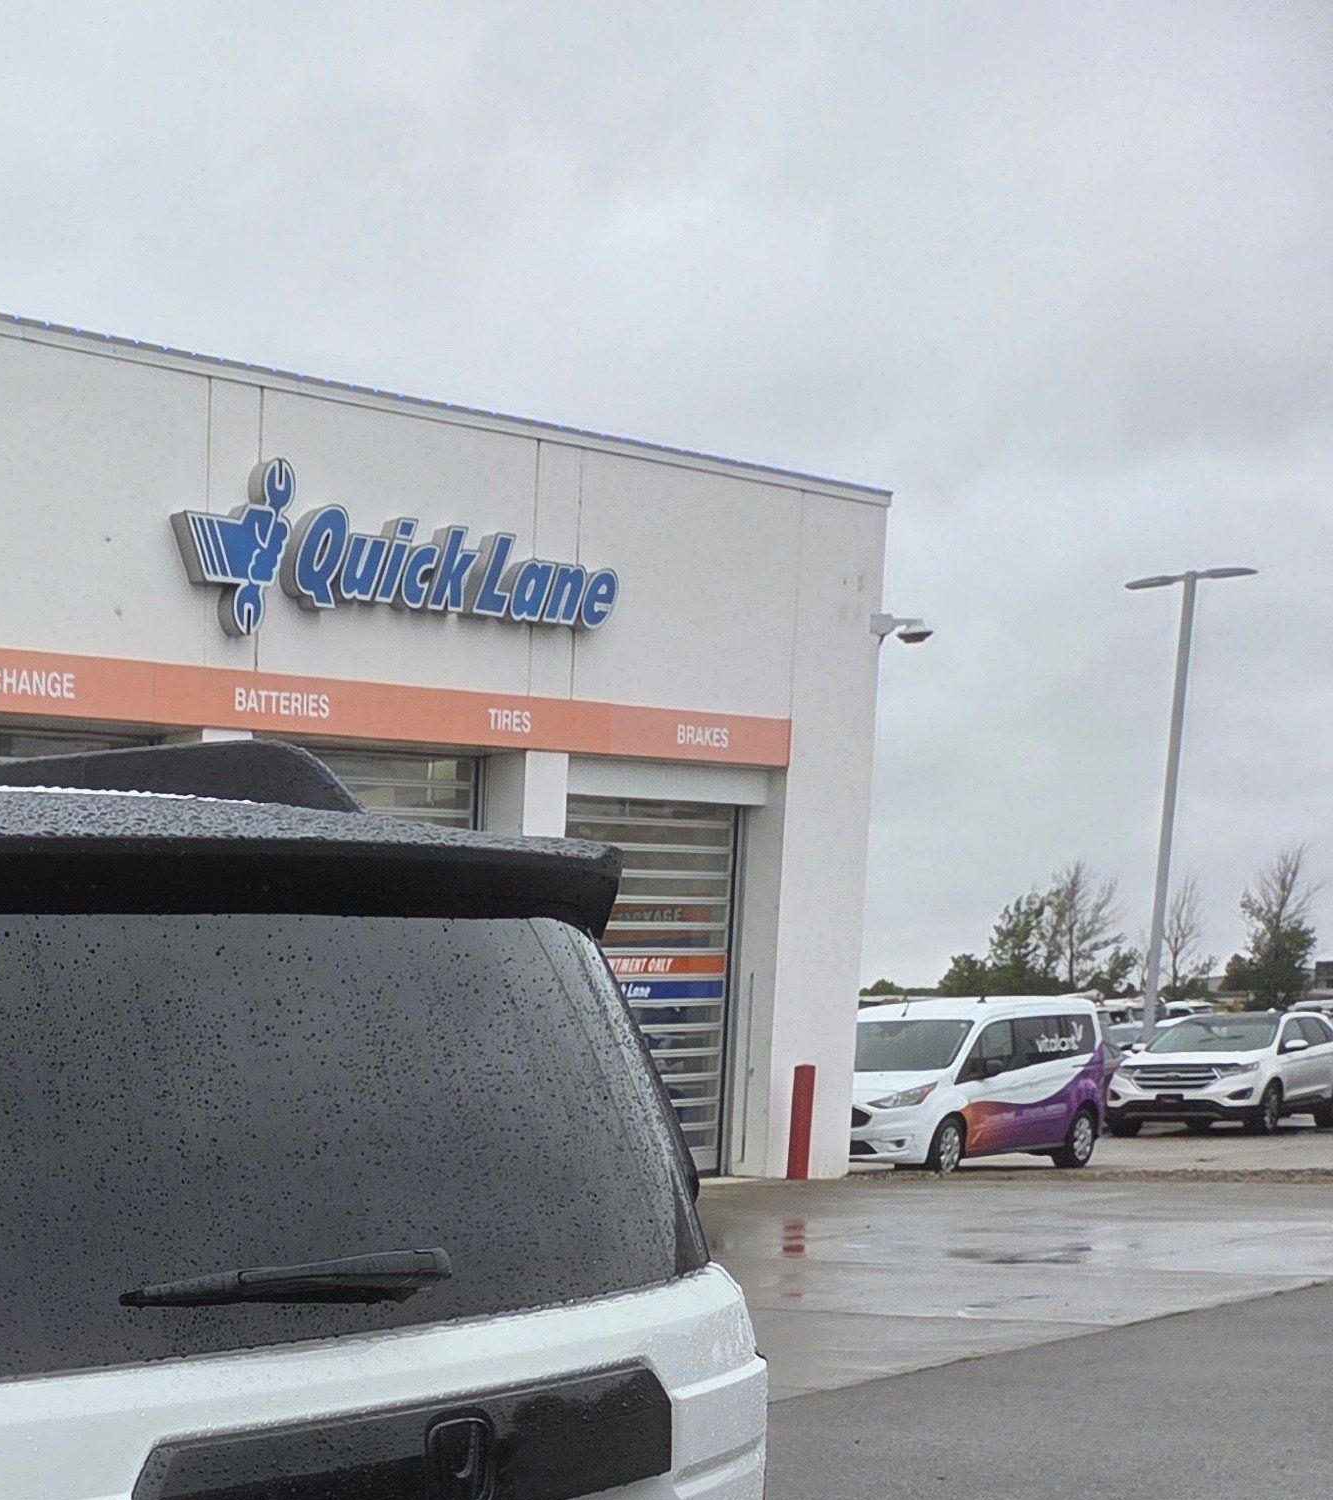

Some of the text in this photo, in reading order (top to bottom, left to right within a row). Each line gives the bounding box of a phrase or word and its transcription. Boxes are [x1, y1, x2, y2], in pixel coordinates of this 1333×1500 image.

[288, 504, 619, 630] Quick Lane
[235, 687, 331, 719] BATTERIES
[487, 707, 531, 734] TIRES
[676, 724, 729, 748] BRAKES
